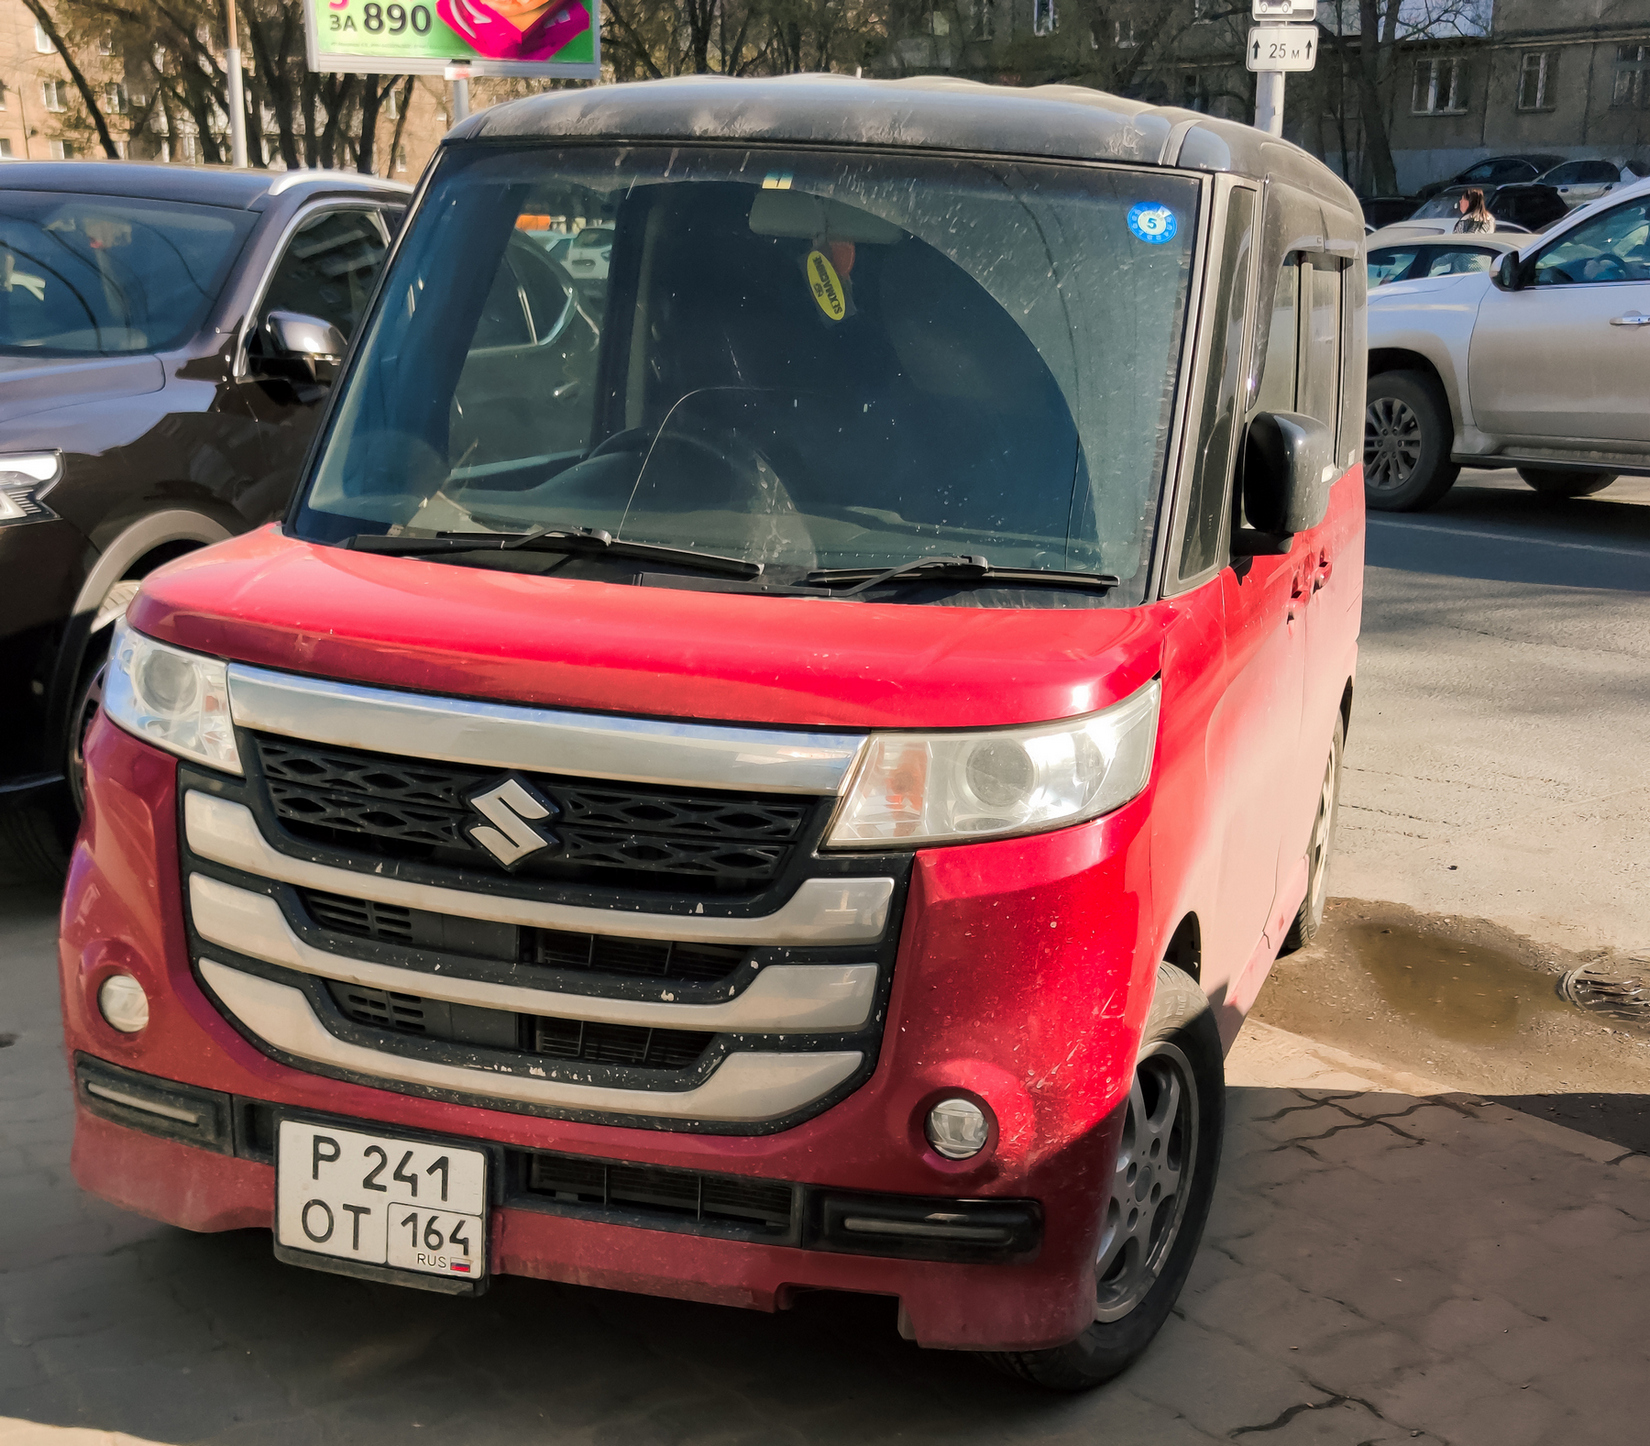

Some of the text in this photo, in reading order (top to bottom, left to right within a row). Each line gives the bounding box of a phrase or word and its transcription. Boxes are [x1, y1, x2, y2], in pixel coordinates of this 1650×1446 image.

[329, 2, 433, 35] ЗА 890
[1269, 43, 1287, 59] 25
[1146, 217, 1158, 230] 5
[312, 1134, 450, 1202] Р 241
[301, 1198, 372, 1251] ОТ
[400, 1212, 470, 1256] 164
[417, 1252, 447, 1269] RUS
